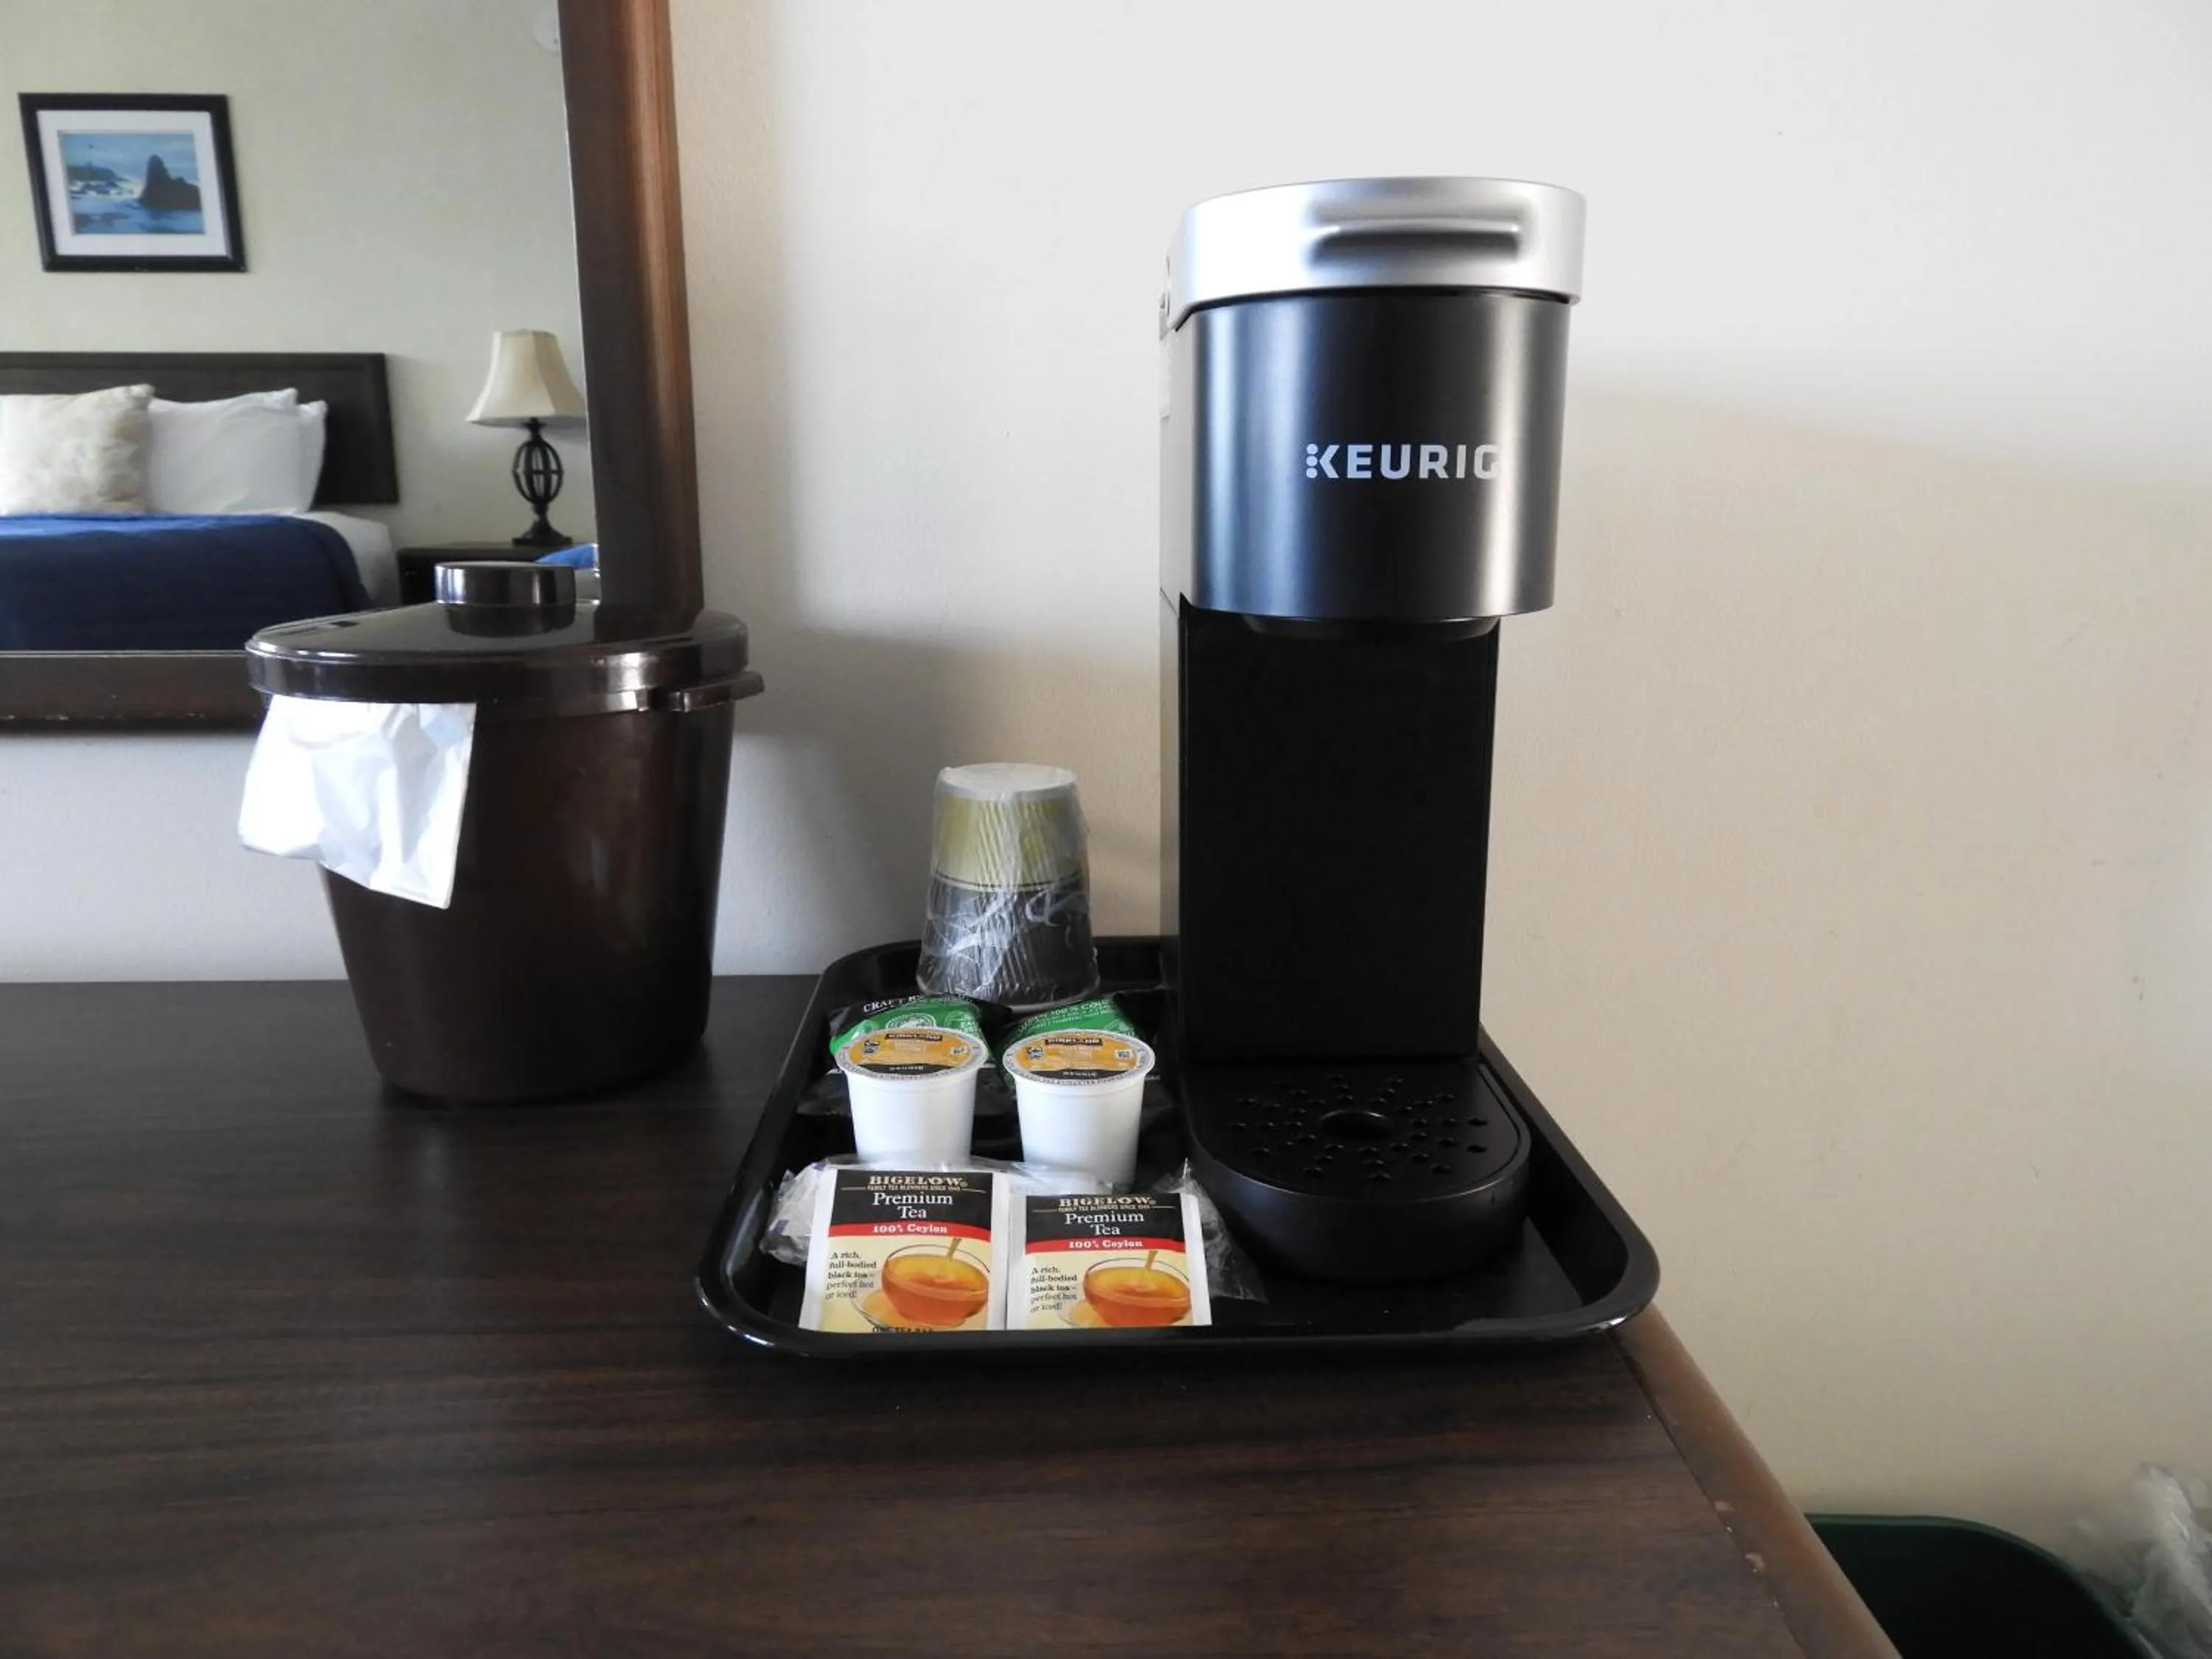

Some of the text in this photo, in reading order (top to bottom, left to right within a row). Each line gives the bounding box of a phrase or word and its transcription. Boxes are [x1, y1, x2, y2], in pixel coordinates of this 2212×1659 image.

[1306, 443, 1501, 479] KEURIG
[872, 1191, 953, 1206] Premium
[897, 1205, 928, 1219] Tea
[1064, 1210, 1145, 1225] Premium
[873, 1223, 949, 1234] 100% Ceylon
[1089, 1223, 1121, 1236] Tea
[1068, 1239, 1144, 1249] 100% Ceylon
